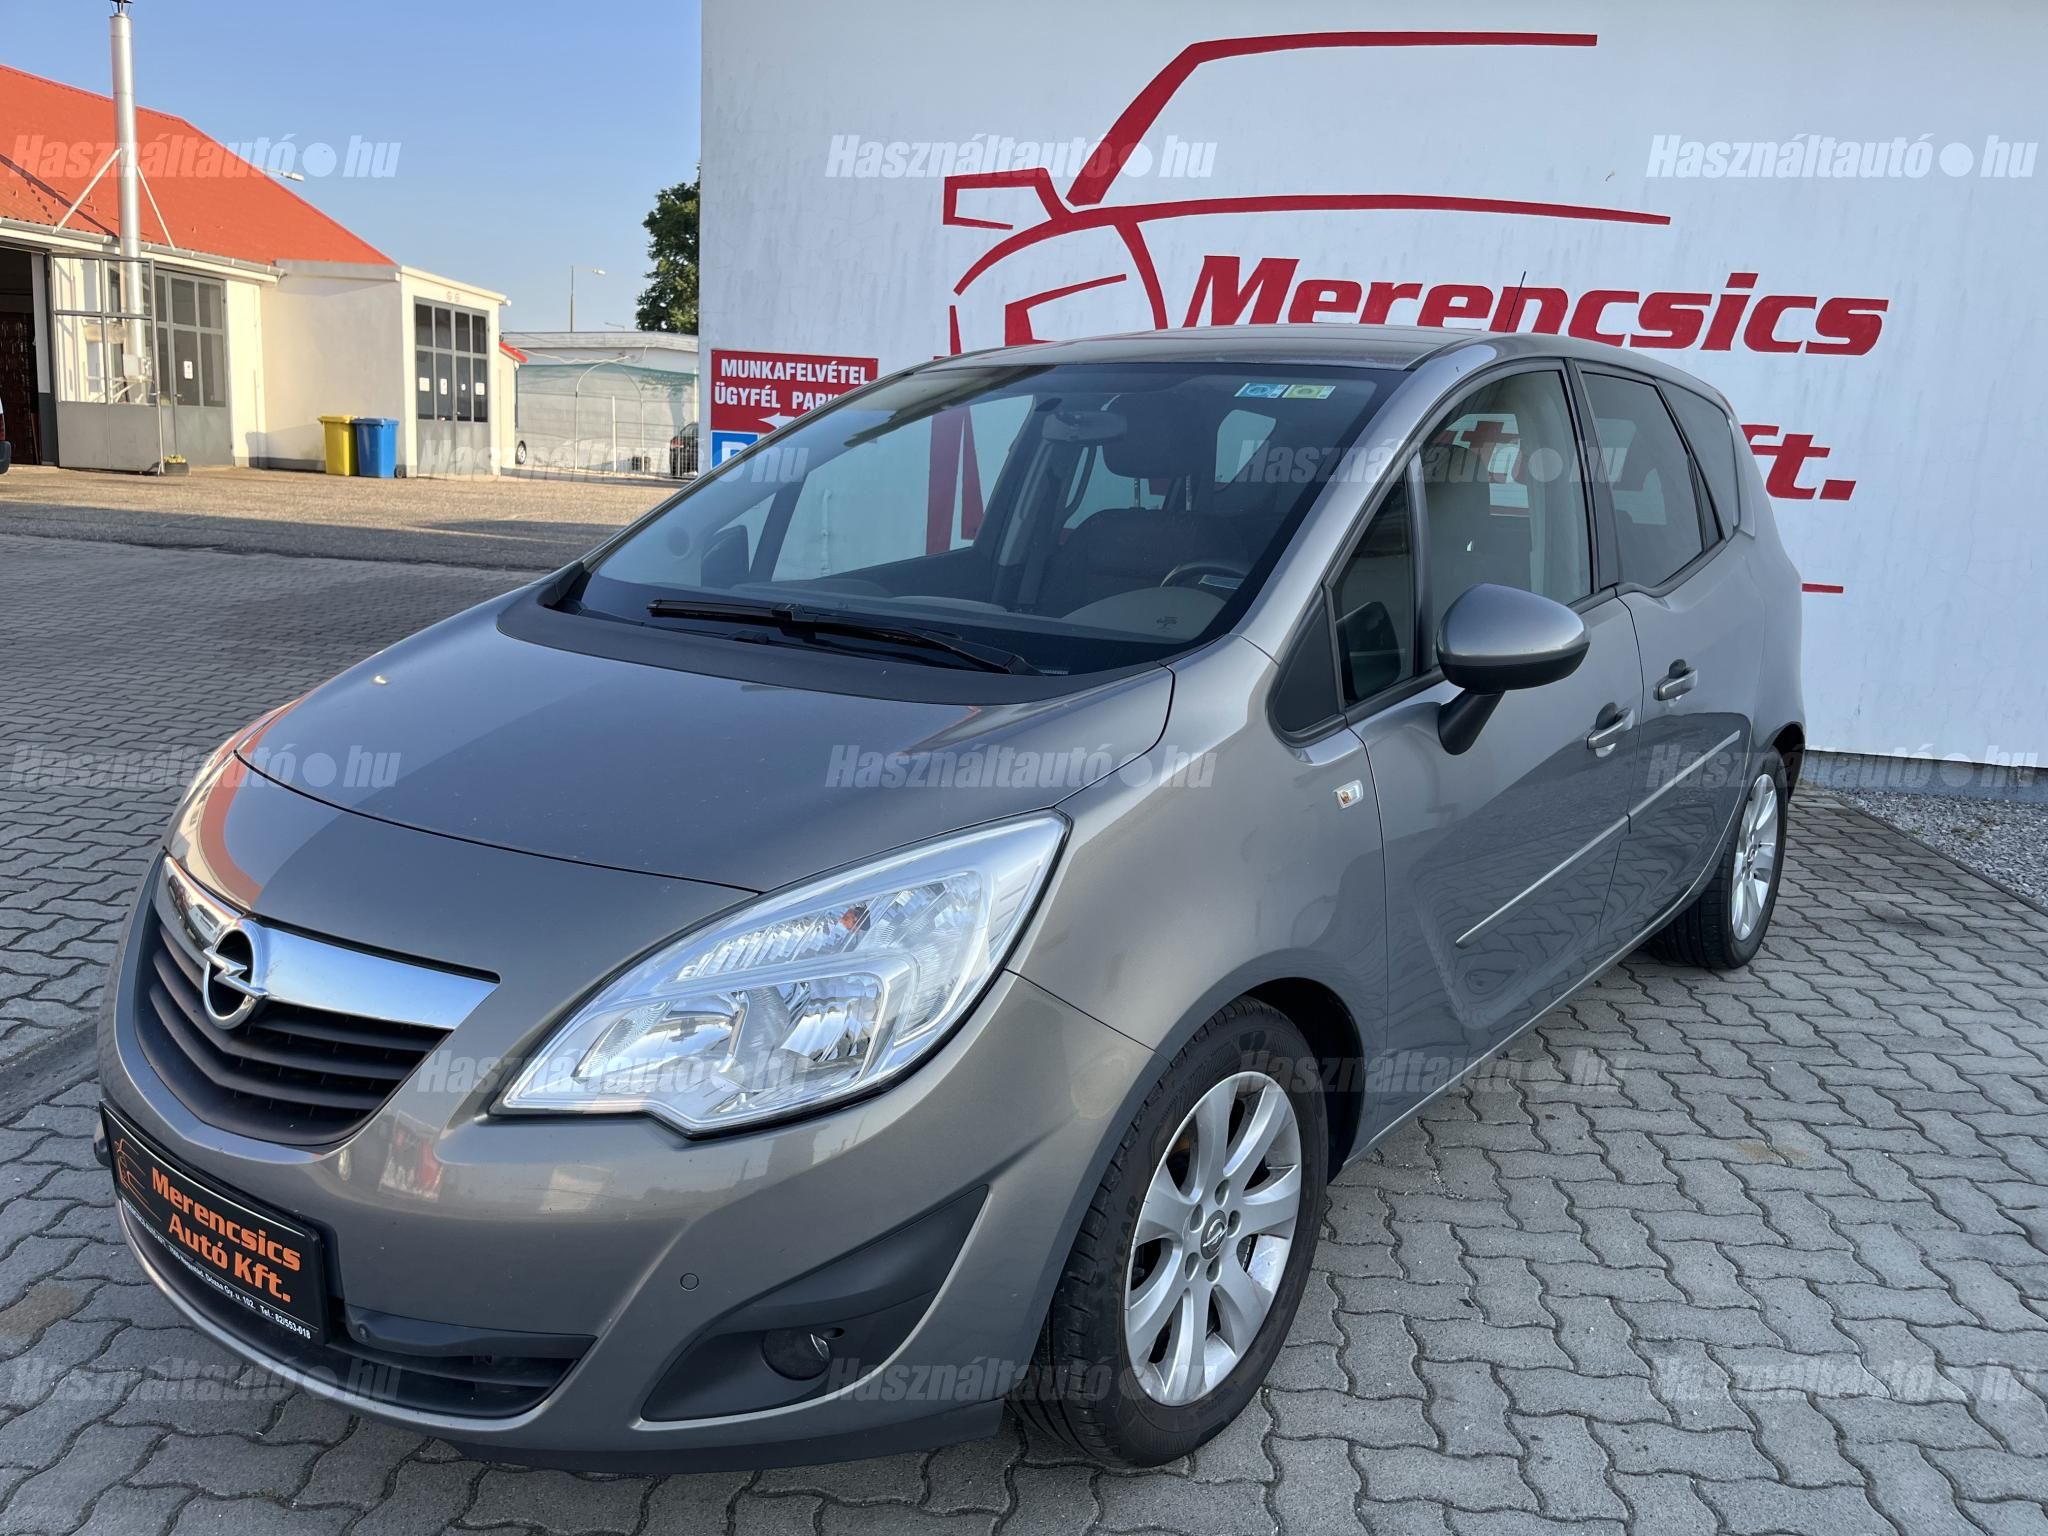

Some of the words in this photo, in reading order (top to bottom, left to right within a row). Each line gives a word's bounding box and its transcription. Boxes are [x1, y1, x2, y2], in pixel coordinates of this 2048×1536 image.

[1182, 255, 1889, 356] Merencsics
[714, 381, 781, 409] ÜGYFÉL
[720, 358, 869, 385] MUNKAFELVÉTEL
[152, 1166, 301, 1271] Merencsics
[168, 1213, 228, 1270] Autó
[234, 1251, 292, 1303] Kft.
